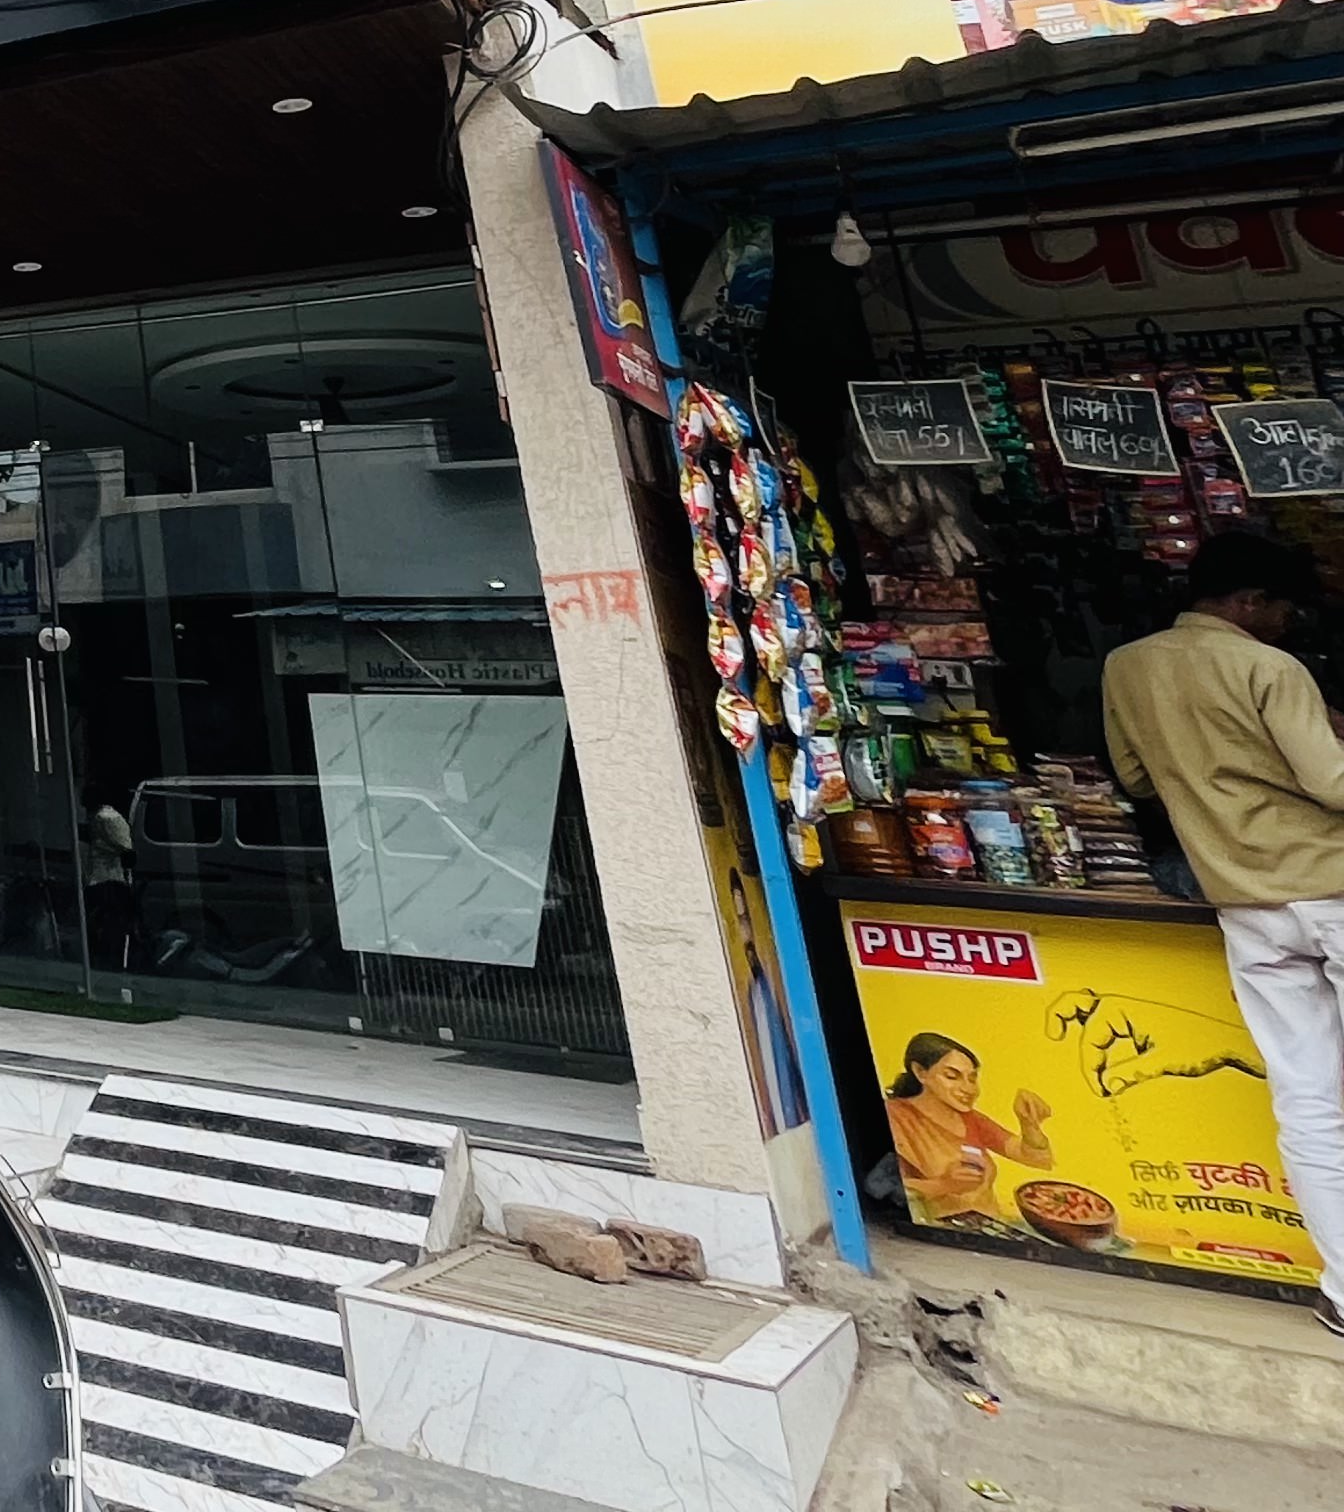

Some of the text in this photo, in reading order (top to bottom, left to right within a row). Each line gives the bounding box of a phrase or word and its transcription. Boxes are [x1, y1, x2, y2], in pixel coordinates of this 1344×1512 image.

[859, 925, 1023, 967] PUSHP
[923, 961, 976, 975] BRAND
[1182, 1161, 1273, 1193] चुटकी
